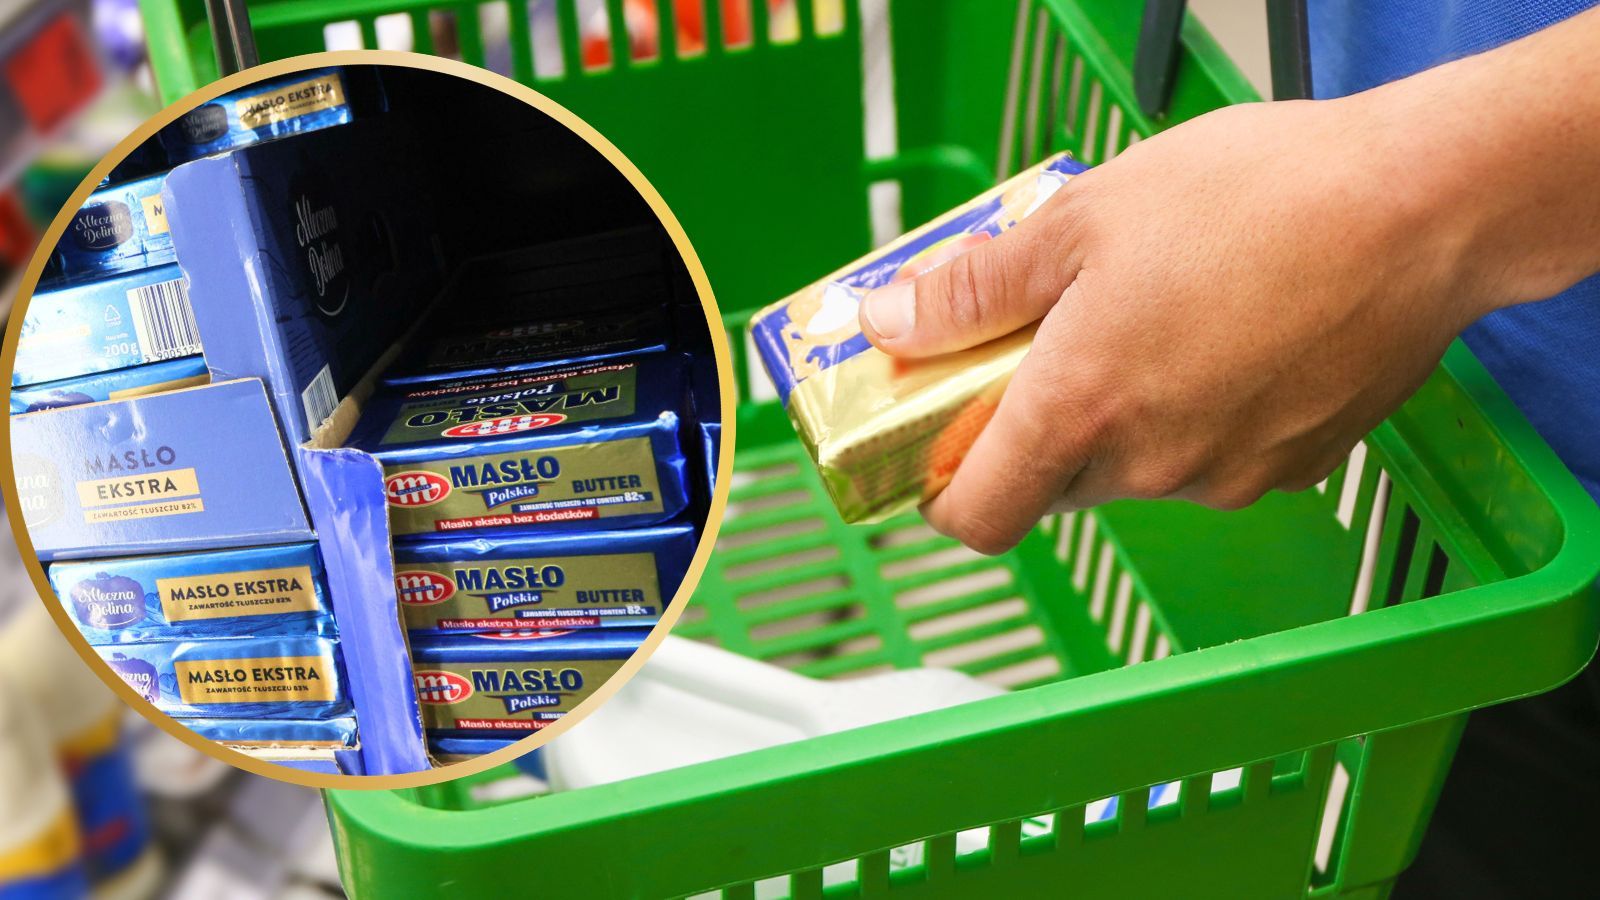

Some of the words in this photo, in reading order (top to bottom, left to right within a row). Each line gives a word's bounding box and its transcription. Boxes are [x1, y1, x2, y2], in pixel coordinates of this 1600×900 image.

[84, 225, 122, 244] Dolina
[467, 384, 555, 405] Polskie
[406, 385, 620, 427] MASŁO
[85, 446, 176, 474] MASŁO
[449, 456, 560, 489] MASŁO
[97, 477, 177, 500] EKSTRA
[572, 474, 642, 494] BUTTER
[488, 485, 535, 505] Polskie
[475, 516, 511, 527] ekstra
[514, 513, 533, 523] bez
[536, 510, 593, 521] dodatków
[454, 565, 565, 591] MASŁO
[78, 588, 135, 603] Mleczna
[170, 583, 228, 601] MASŁO
[235, 578, 303, 596] EKSTRA
[576, 589, 645, 604] BUTTER
[88, 601, 133, 617] Dolina
[493, 594, 539, 610] Polskie
[477, 620, 513, 628] ekstra
[515, 619, 535, 627] bez
[538, 618, 595, 627] dodatków
[188, 669, 246, 684] MASŁO
[253, 667, 319, 681] EKSTRA
[471, 668, 584, 692] MASŁO
[511, 697, 557, 711] Polskie
[495, 720, 531, 728] ekstra
